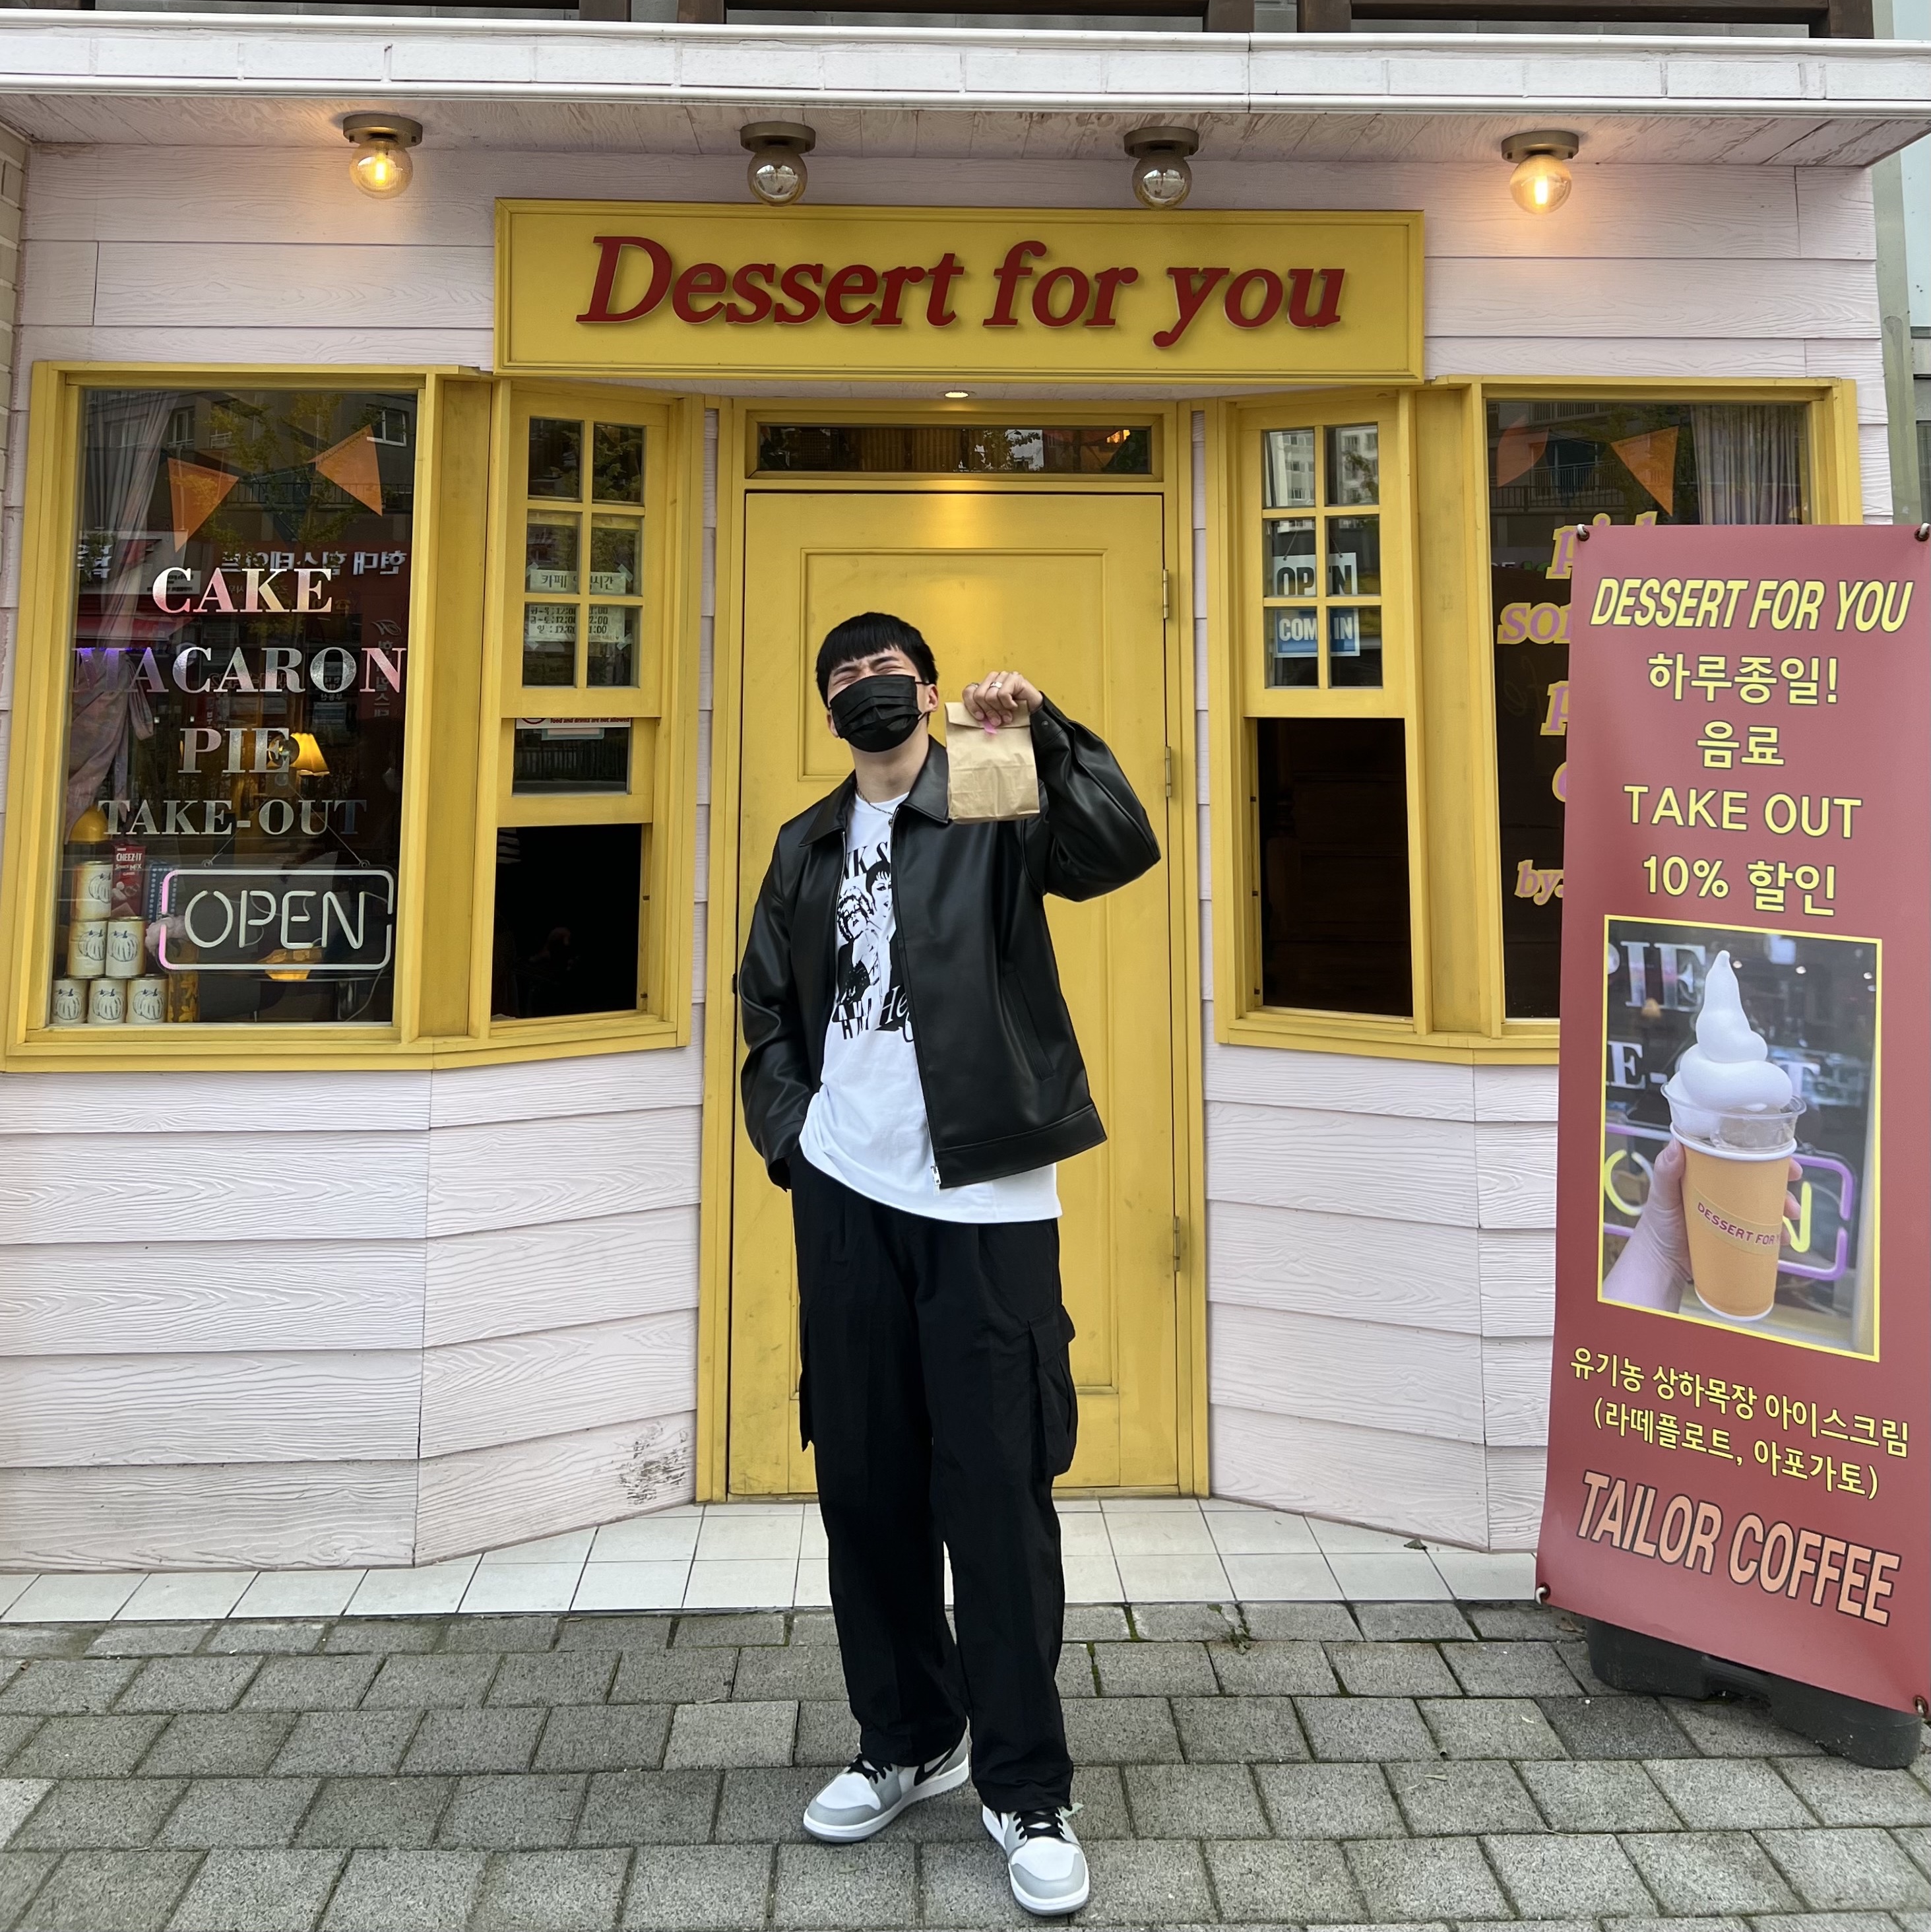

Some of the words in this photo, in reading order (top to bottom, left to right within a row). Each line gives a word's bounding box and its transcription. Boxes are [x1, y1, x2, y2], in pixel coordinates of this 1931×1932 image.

[576, 235, 963, 328] Dessert
[983, 240, 1139, 329] for
[1153, 266, 1345, 349] you
[152, 567, 332, 614] CAKE
[542, 575, 567, 588] 카페
[1277, 564, 1352, 596] OPN
[1334, 616, 1354, 641] IN
[1591, 578, 1748, 629] DESSERT
[1748, 580, 1825, 631] FOR
[1835, 581, 1914, 633] YOU
[70, 647, 406, 694] MACARON
[1648, 653, 1838, 705] 하루종일!
[177, 728, 290, 774] PIE
[1697, 721, 1785, 769] 음료
[96, 799, 367, 836] TAKE-OUT
[1624, 785, 1748, 831] TAKE
[1764, 793, 1862, 839] OUT
[1643, 855, 1729, 899] 10%
[1748, 860, 1836, 917] 할인
[185, 889, 365, 950] OPEN
[1697, 1202, 1754, 1241] DESSERT
[1755, 1233, 1775, 1245] FOR
[1570, 1347, 1645, 1392] 유기농
[1653, 1365, 1757, 1420] 상하목장
[1765, 1394, 1909, 1458] 아이스크림
[1594, 1397, 1743, 1465] (라떼플로트,
[1754, 1439, 1878, 1500] 아포가토)
[1576, 1470, 1723, 1574] TAILOR
[1728, 1512, 1901, 1626] COFFEE
